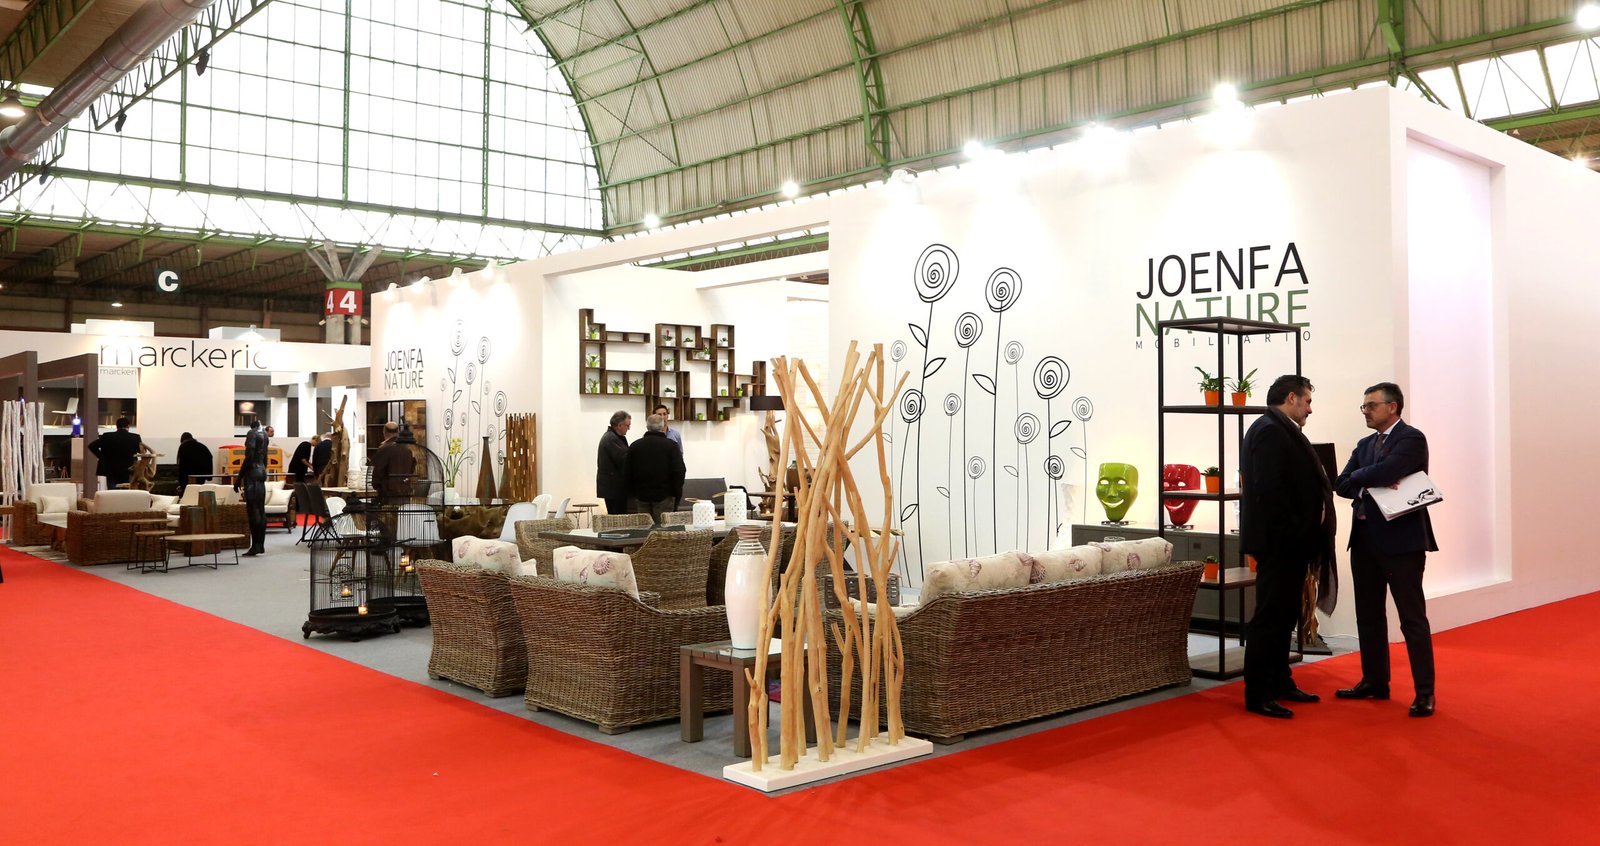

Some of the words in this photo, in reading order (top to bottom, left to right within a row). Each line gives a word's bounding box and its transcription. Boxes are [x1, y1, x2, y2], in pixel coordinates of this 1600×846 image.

[158, 271, 179, 292] C
[1136, 242, 1309, 300] JOENFA
[327, 291, 334, 313] 4
[340, 291, 357, 313] 4
[1136, 289, 1310, 337] NATURE
[385, 348, 424, 371] JOENFA
[385, 370, 424, 390] NATURE
